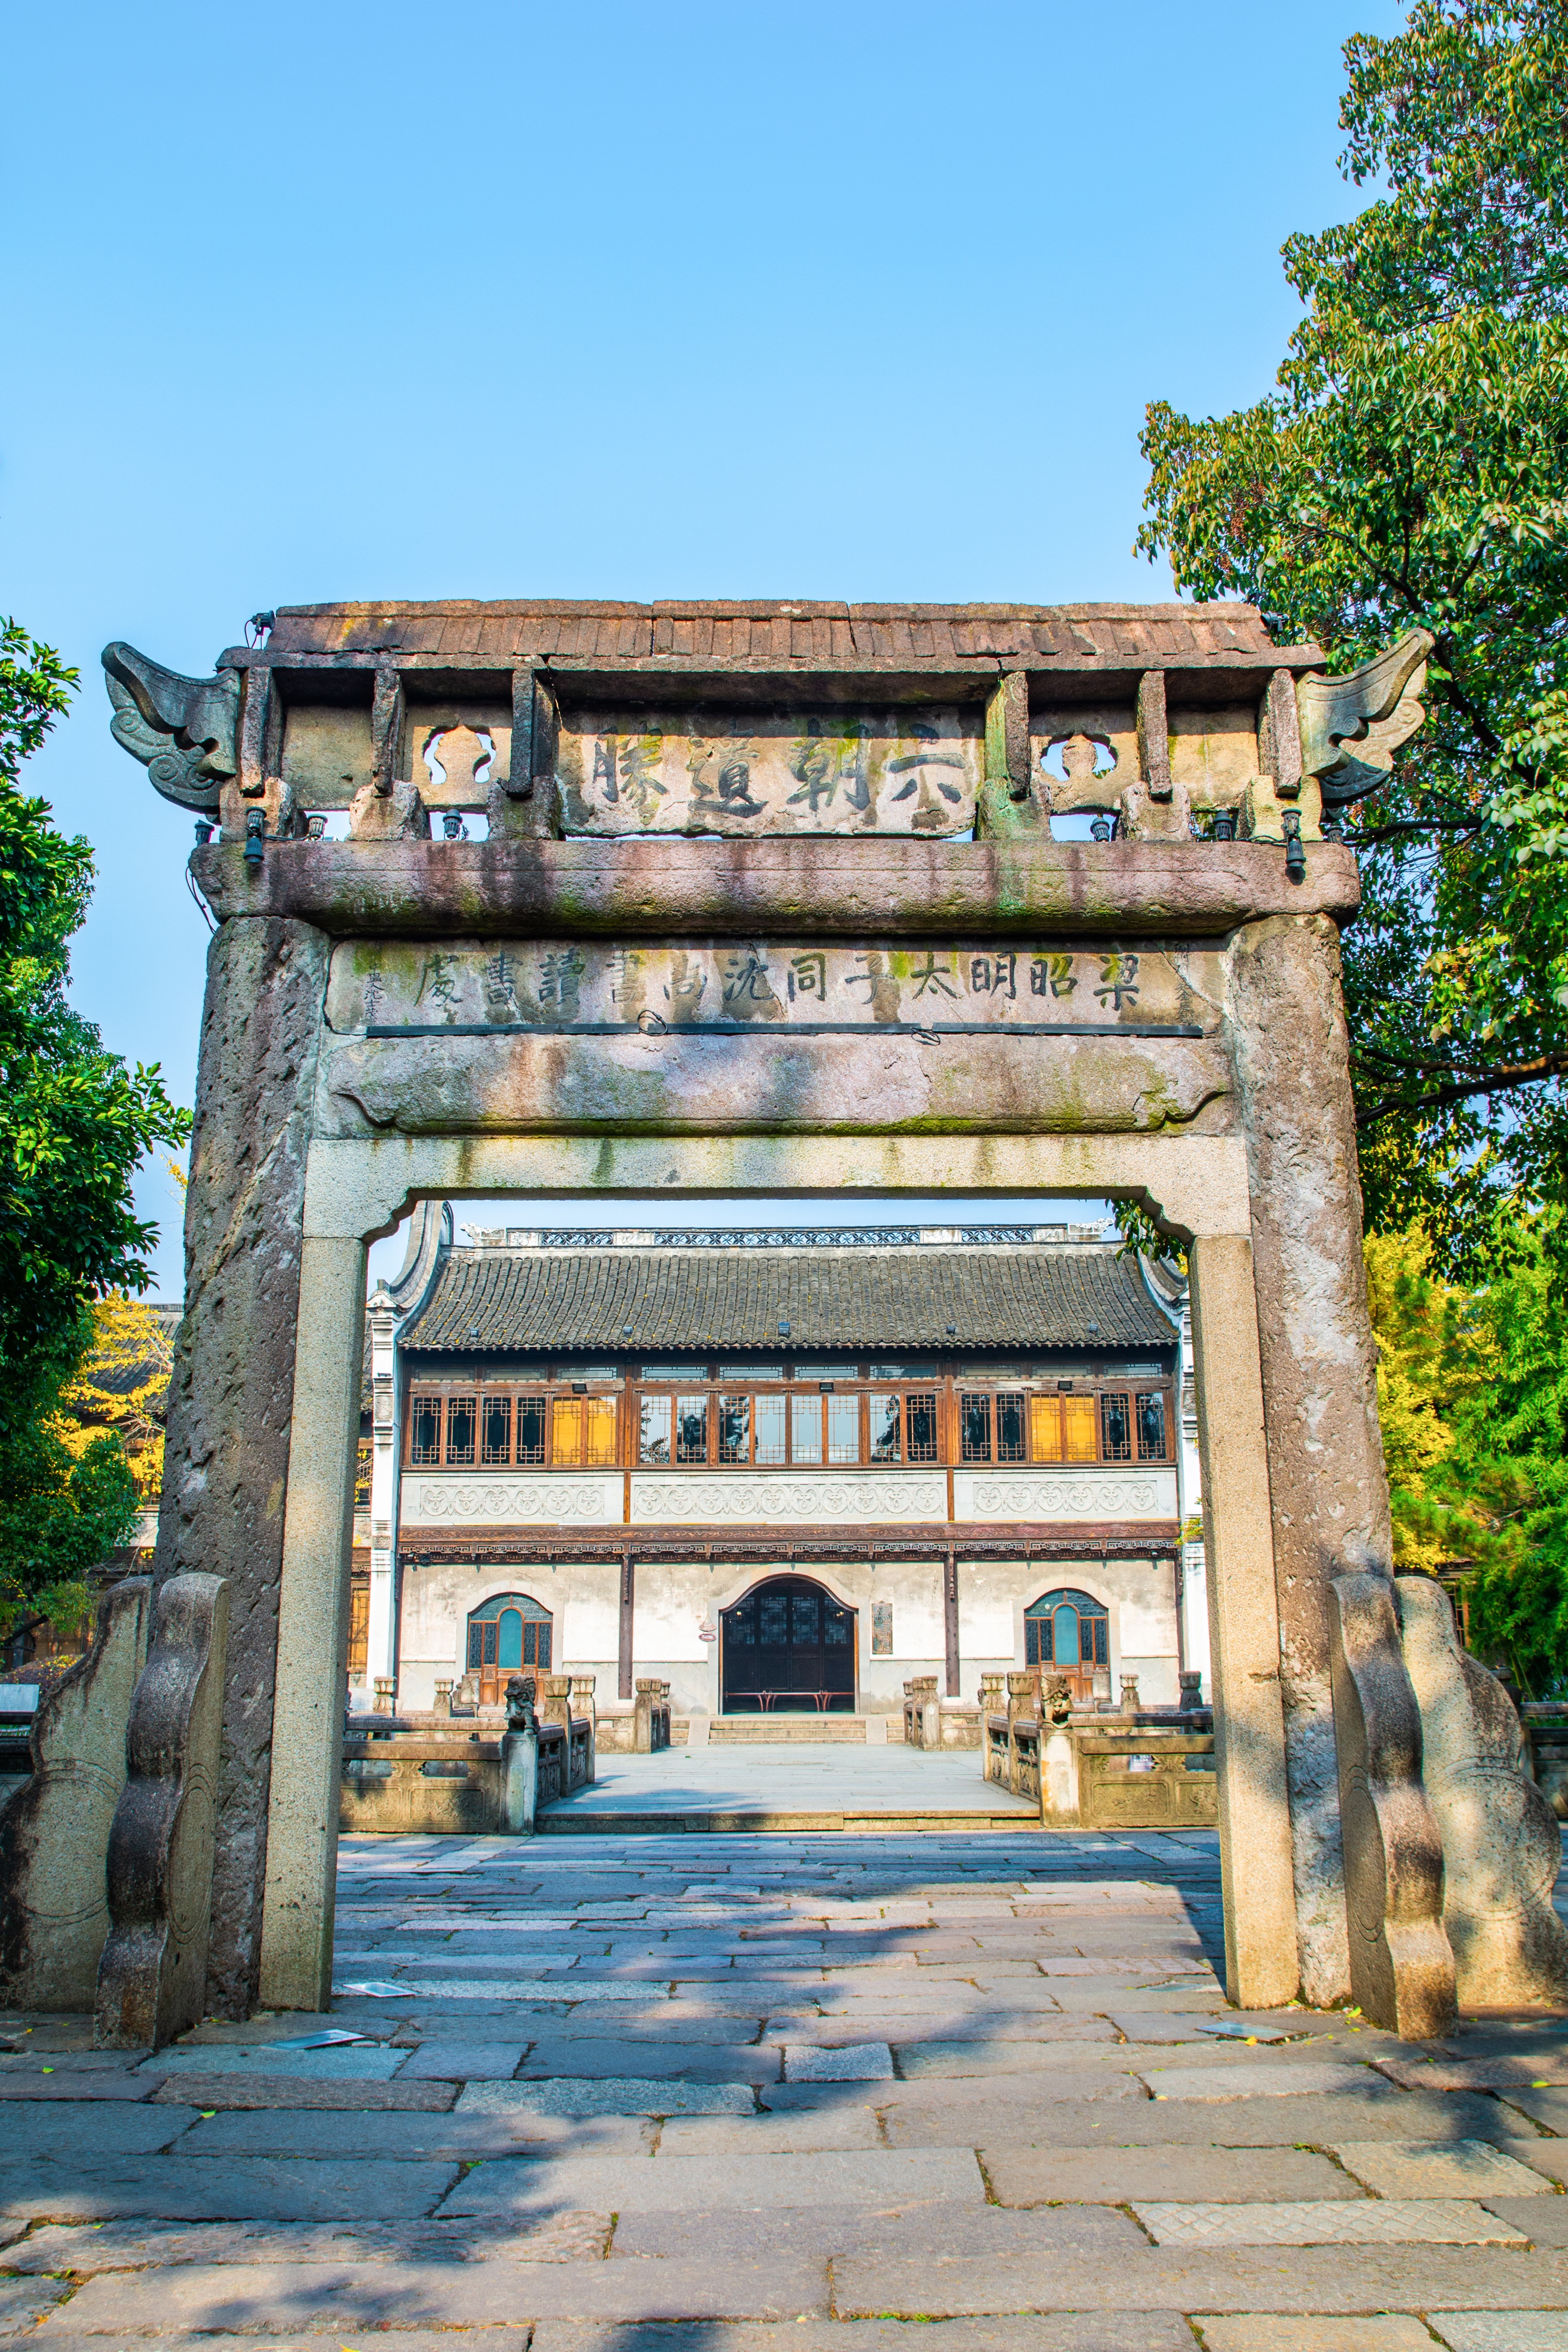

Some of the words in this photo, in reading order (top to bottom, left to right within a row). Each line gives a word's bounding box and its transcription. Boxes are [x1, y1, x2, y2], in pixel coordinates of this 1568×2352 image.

[591, 718, 967, 821] 六朝遺勝
[414, 949, 1140, 1010] 梁昭明太子同沈尚書讀書處
